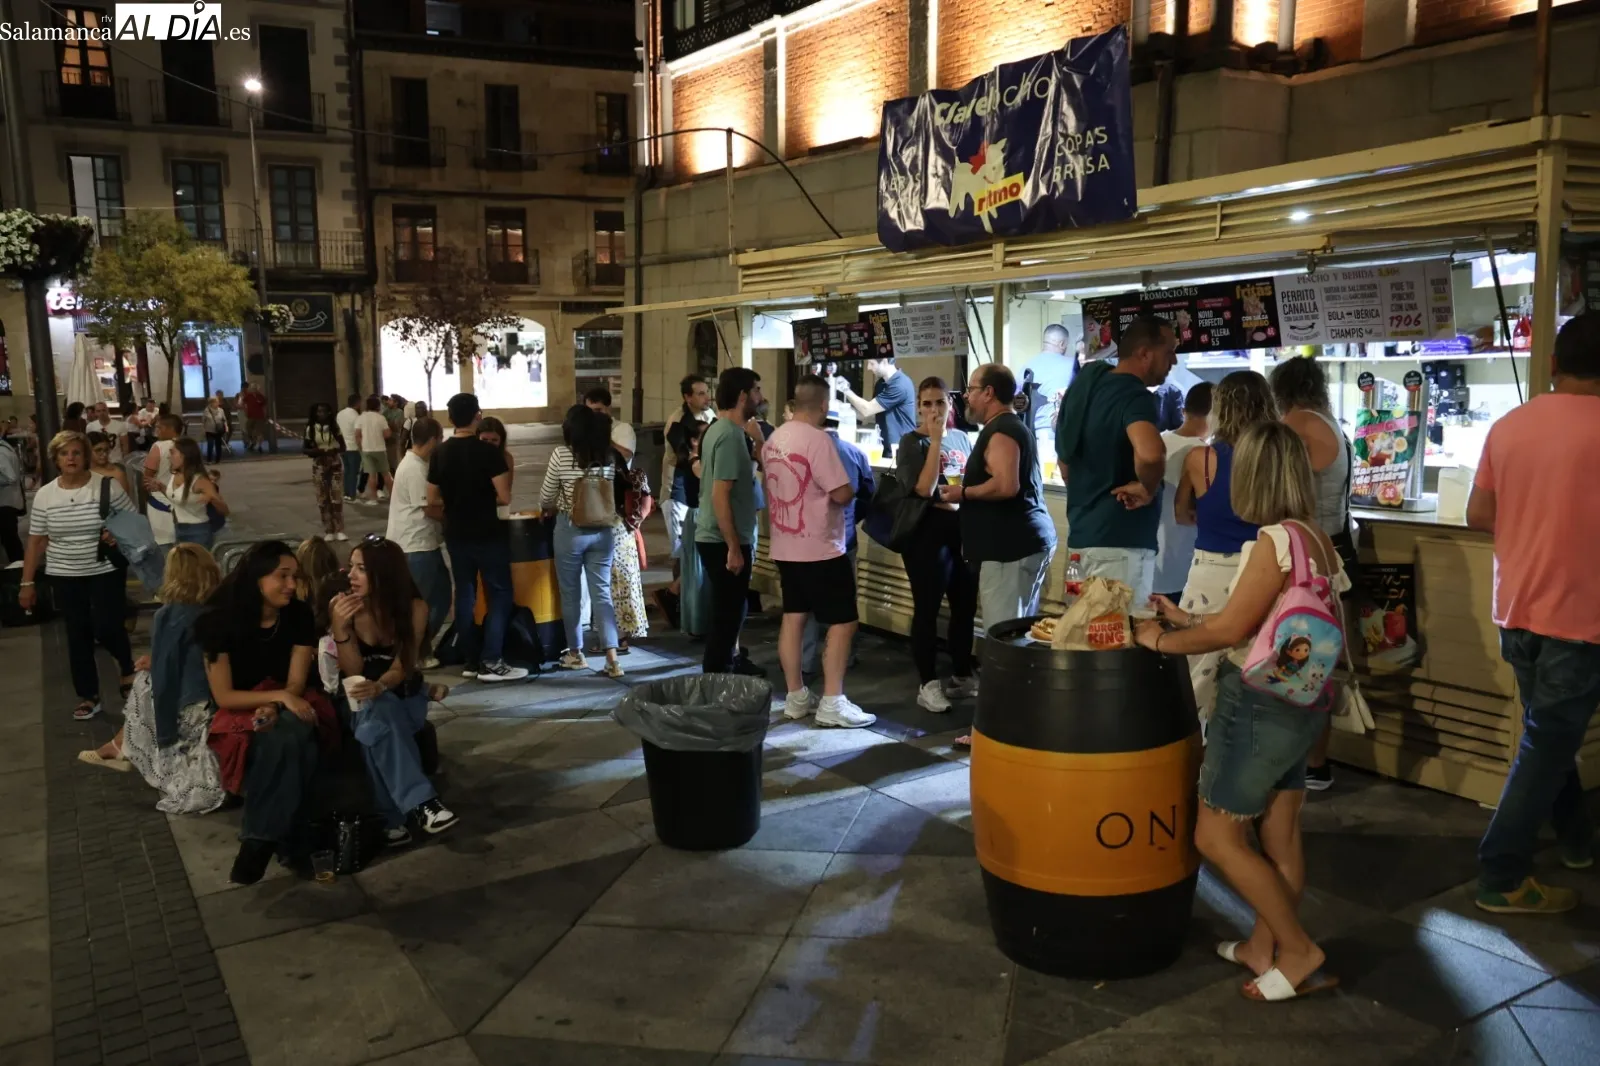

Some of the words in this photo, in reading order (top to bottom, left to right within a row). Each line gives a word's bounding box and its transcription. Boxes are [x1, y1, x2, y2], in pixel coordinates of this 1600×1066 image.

[1055, 126, 1108, 157] COPAS
[1052, 153, 1110, 183] BRASA
[977, 182, 1021, 212] ritmo
[1342, 270, 1374, 280] BEBIDA
[1140, 286, 1199, 301] PROMOCIONES
[1281, 288, 1315, 303] PERRITO
[1282, 301, 1319, 315] CANALLA
[1198, 318, 1223, 328] PERFECTO
[1327, 311, 1345, 321] BOLA
[1389, 312, 1422, 328] 1906
[1210, 328, 1230, 337] YLLERA
[1330, 328, 1364, 340] CHAMPIS
[1088, 621, 1124, 633] BURGER
[1088, 631, 1126, 646] KING
[1096, 804, 1176, 849] ON
